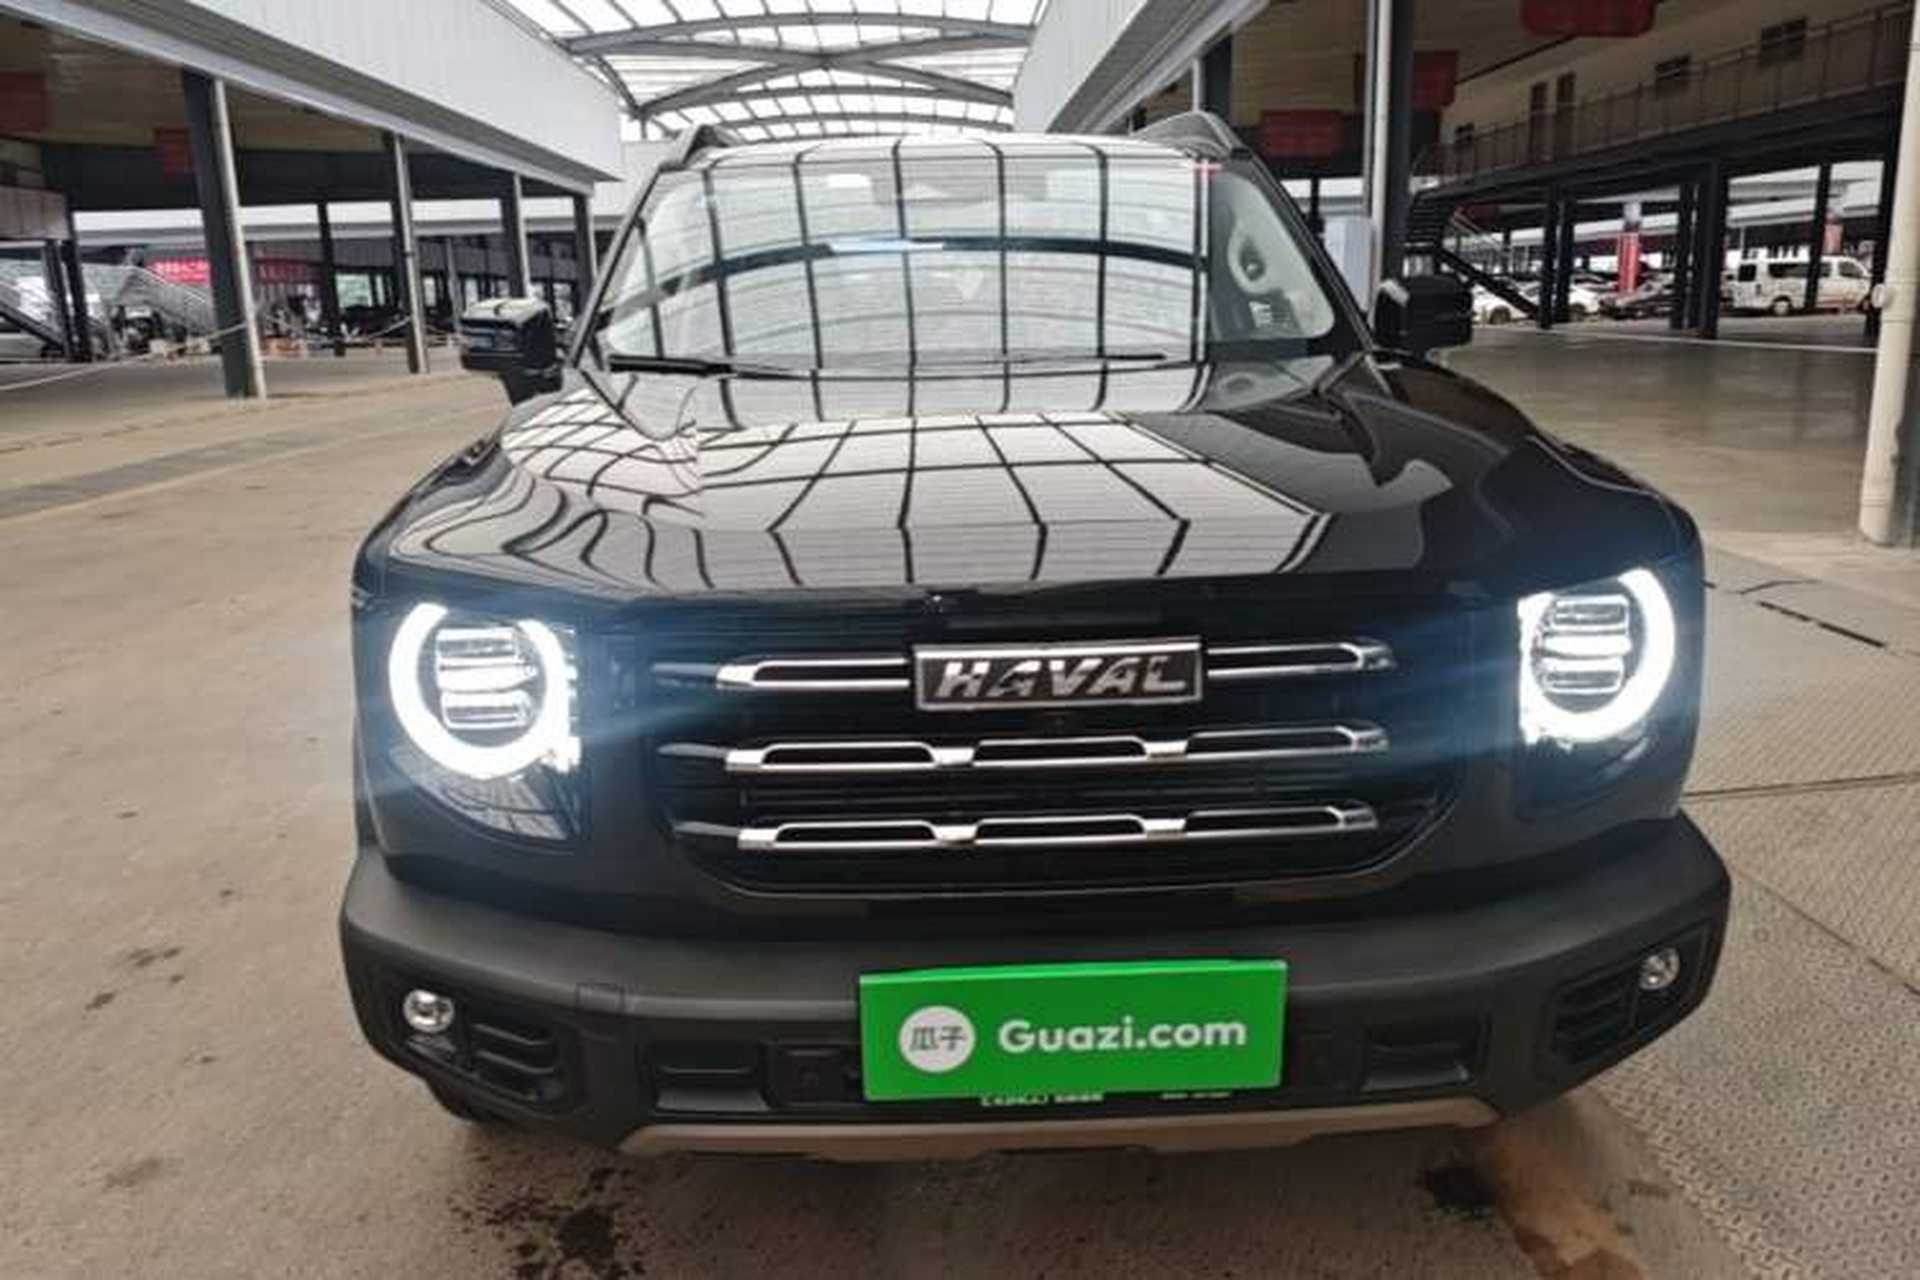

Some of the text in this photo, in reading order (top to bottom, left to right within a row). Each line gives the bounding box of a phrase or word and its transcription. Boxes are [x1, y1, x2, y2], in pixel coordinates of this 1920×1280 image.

[933, 655, 1187, 697] HAVAL
[909, 1026, 969, 1052] 瓜子
[998, 1016, 1248, 1054] Guazi.com
